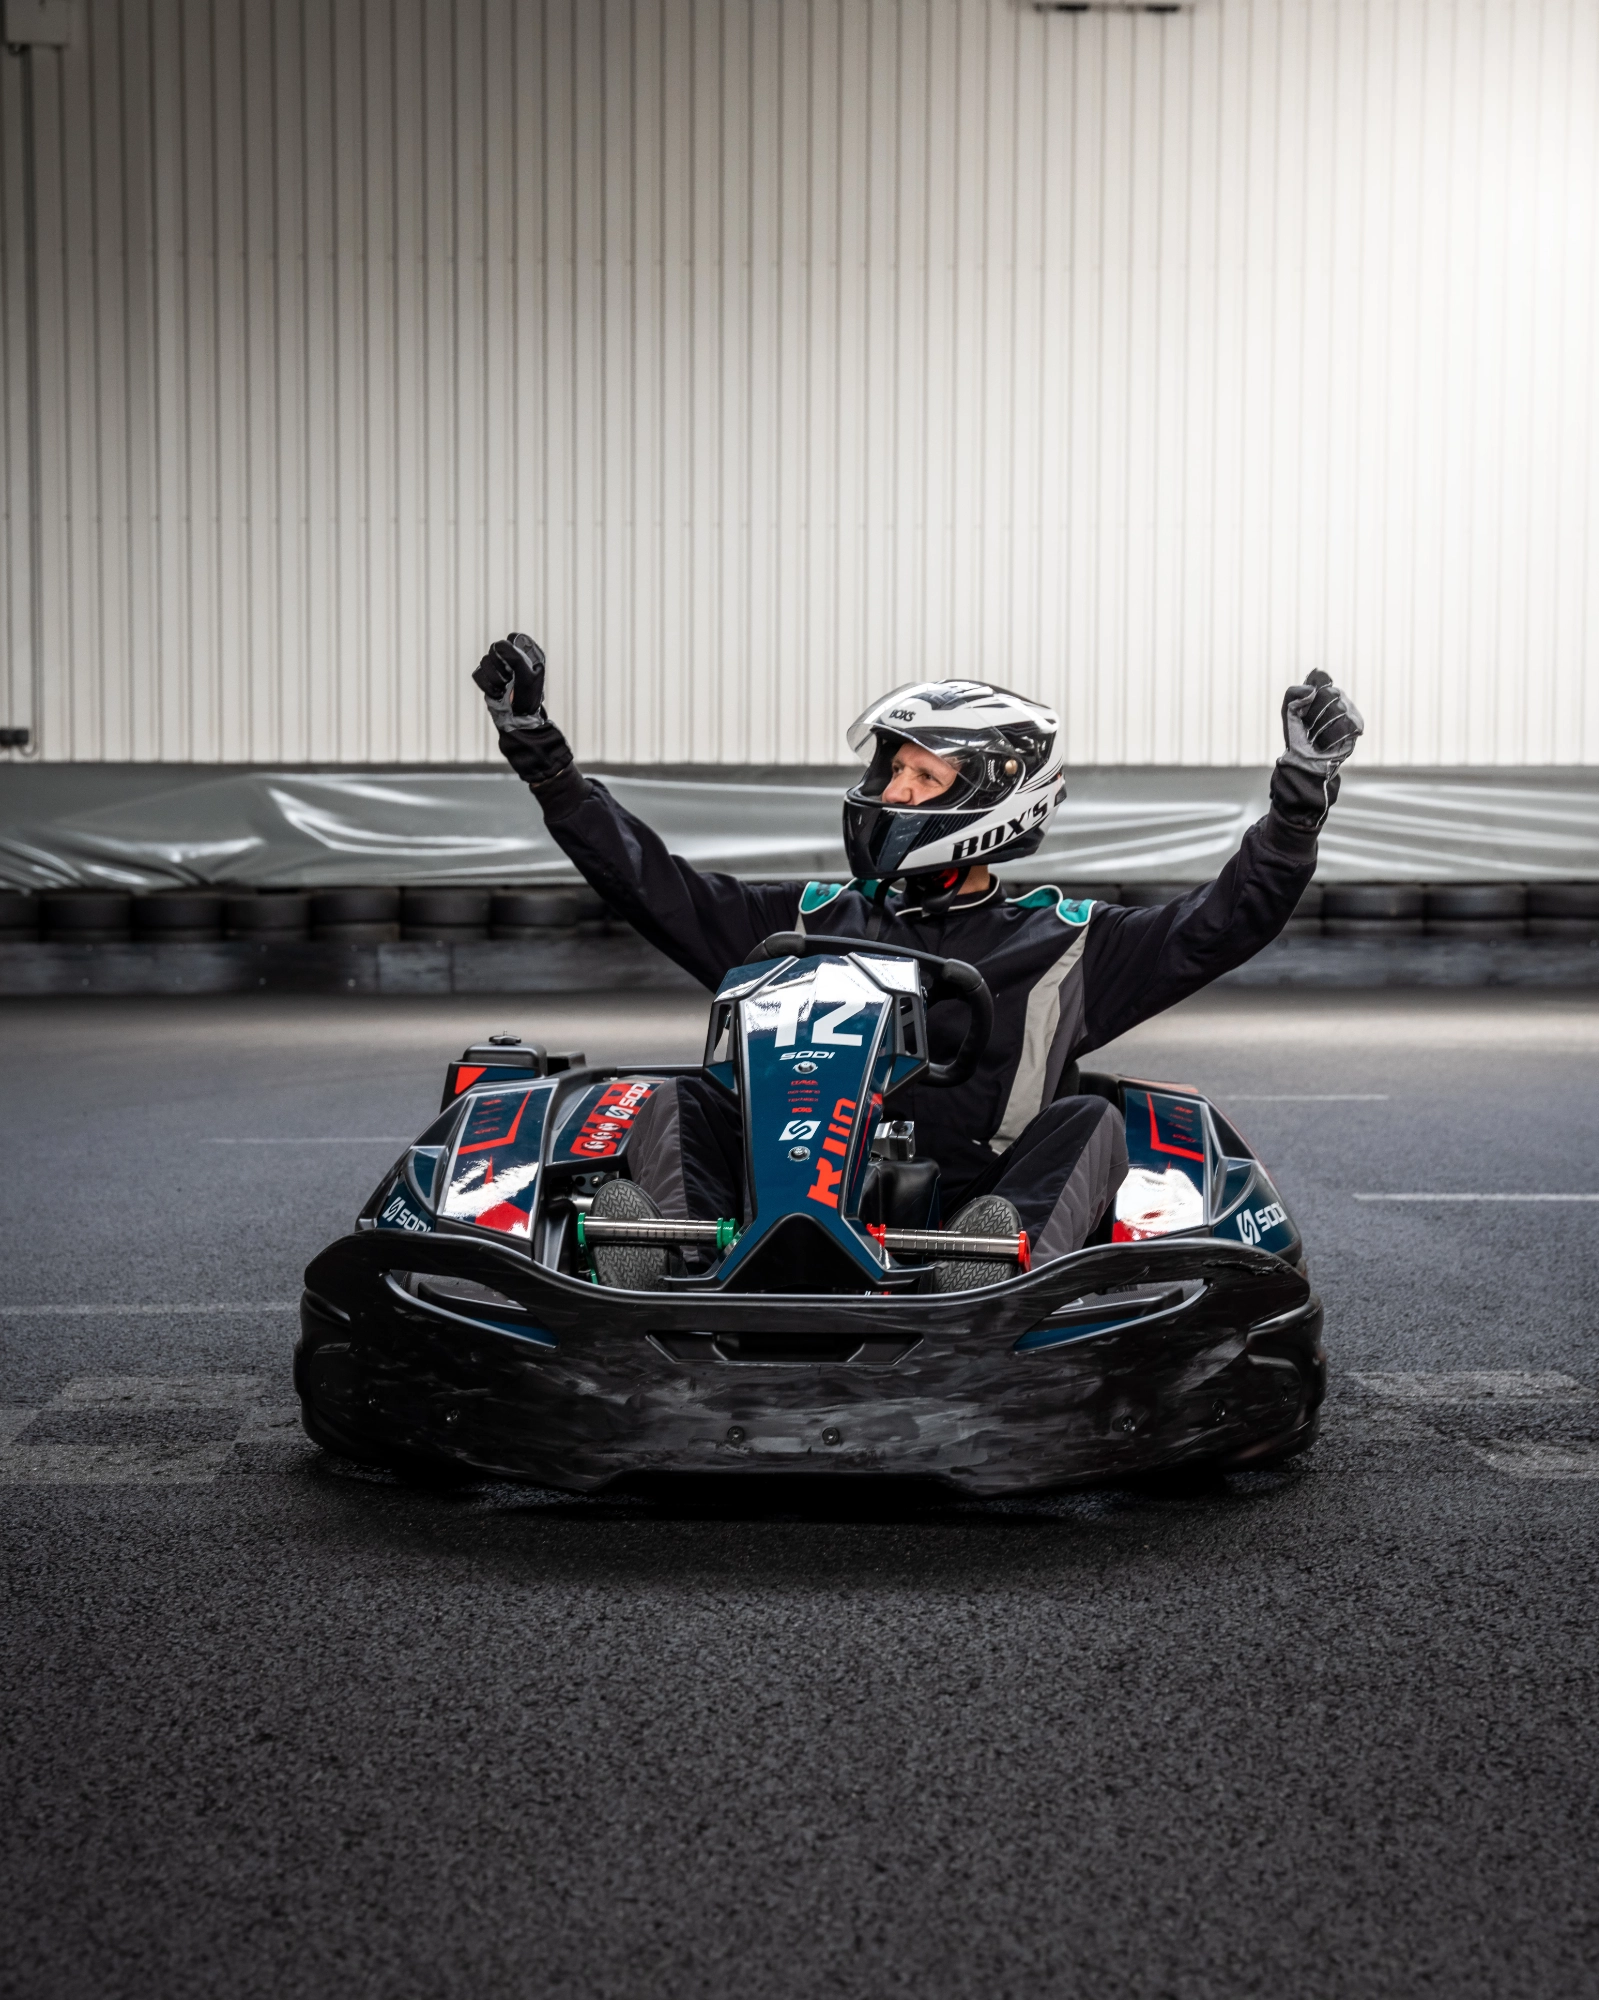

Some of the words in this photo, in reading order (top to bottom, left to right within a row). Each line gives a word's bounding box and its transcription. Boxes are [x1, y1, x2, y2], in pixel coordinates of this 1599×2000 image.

[888, 709, 917, 722] BOXS
[951, 793, 1050, 862] BOX'S
[774, 984, 867, 1048] 12
[779, 1050, 836, 1061] SODI
